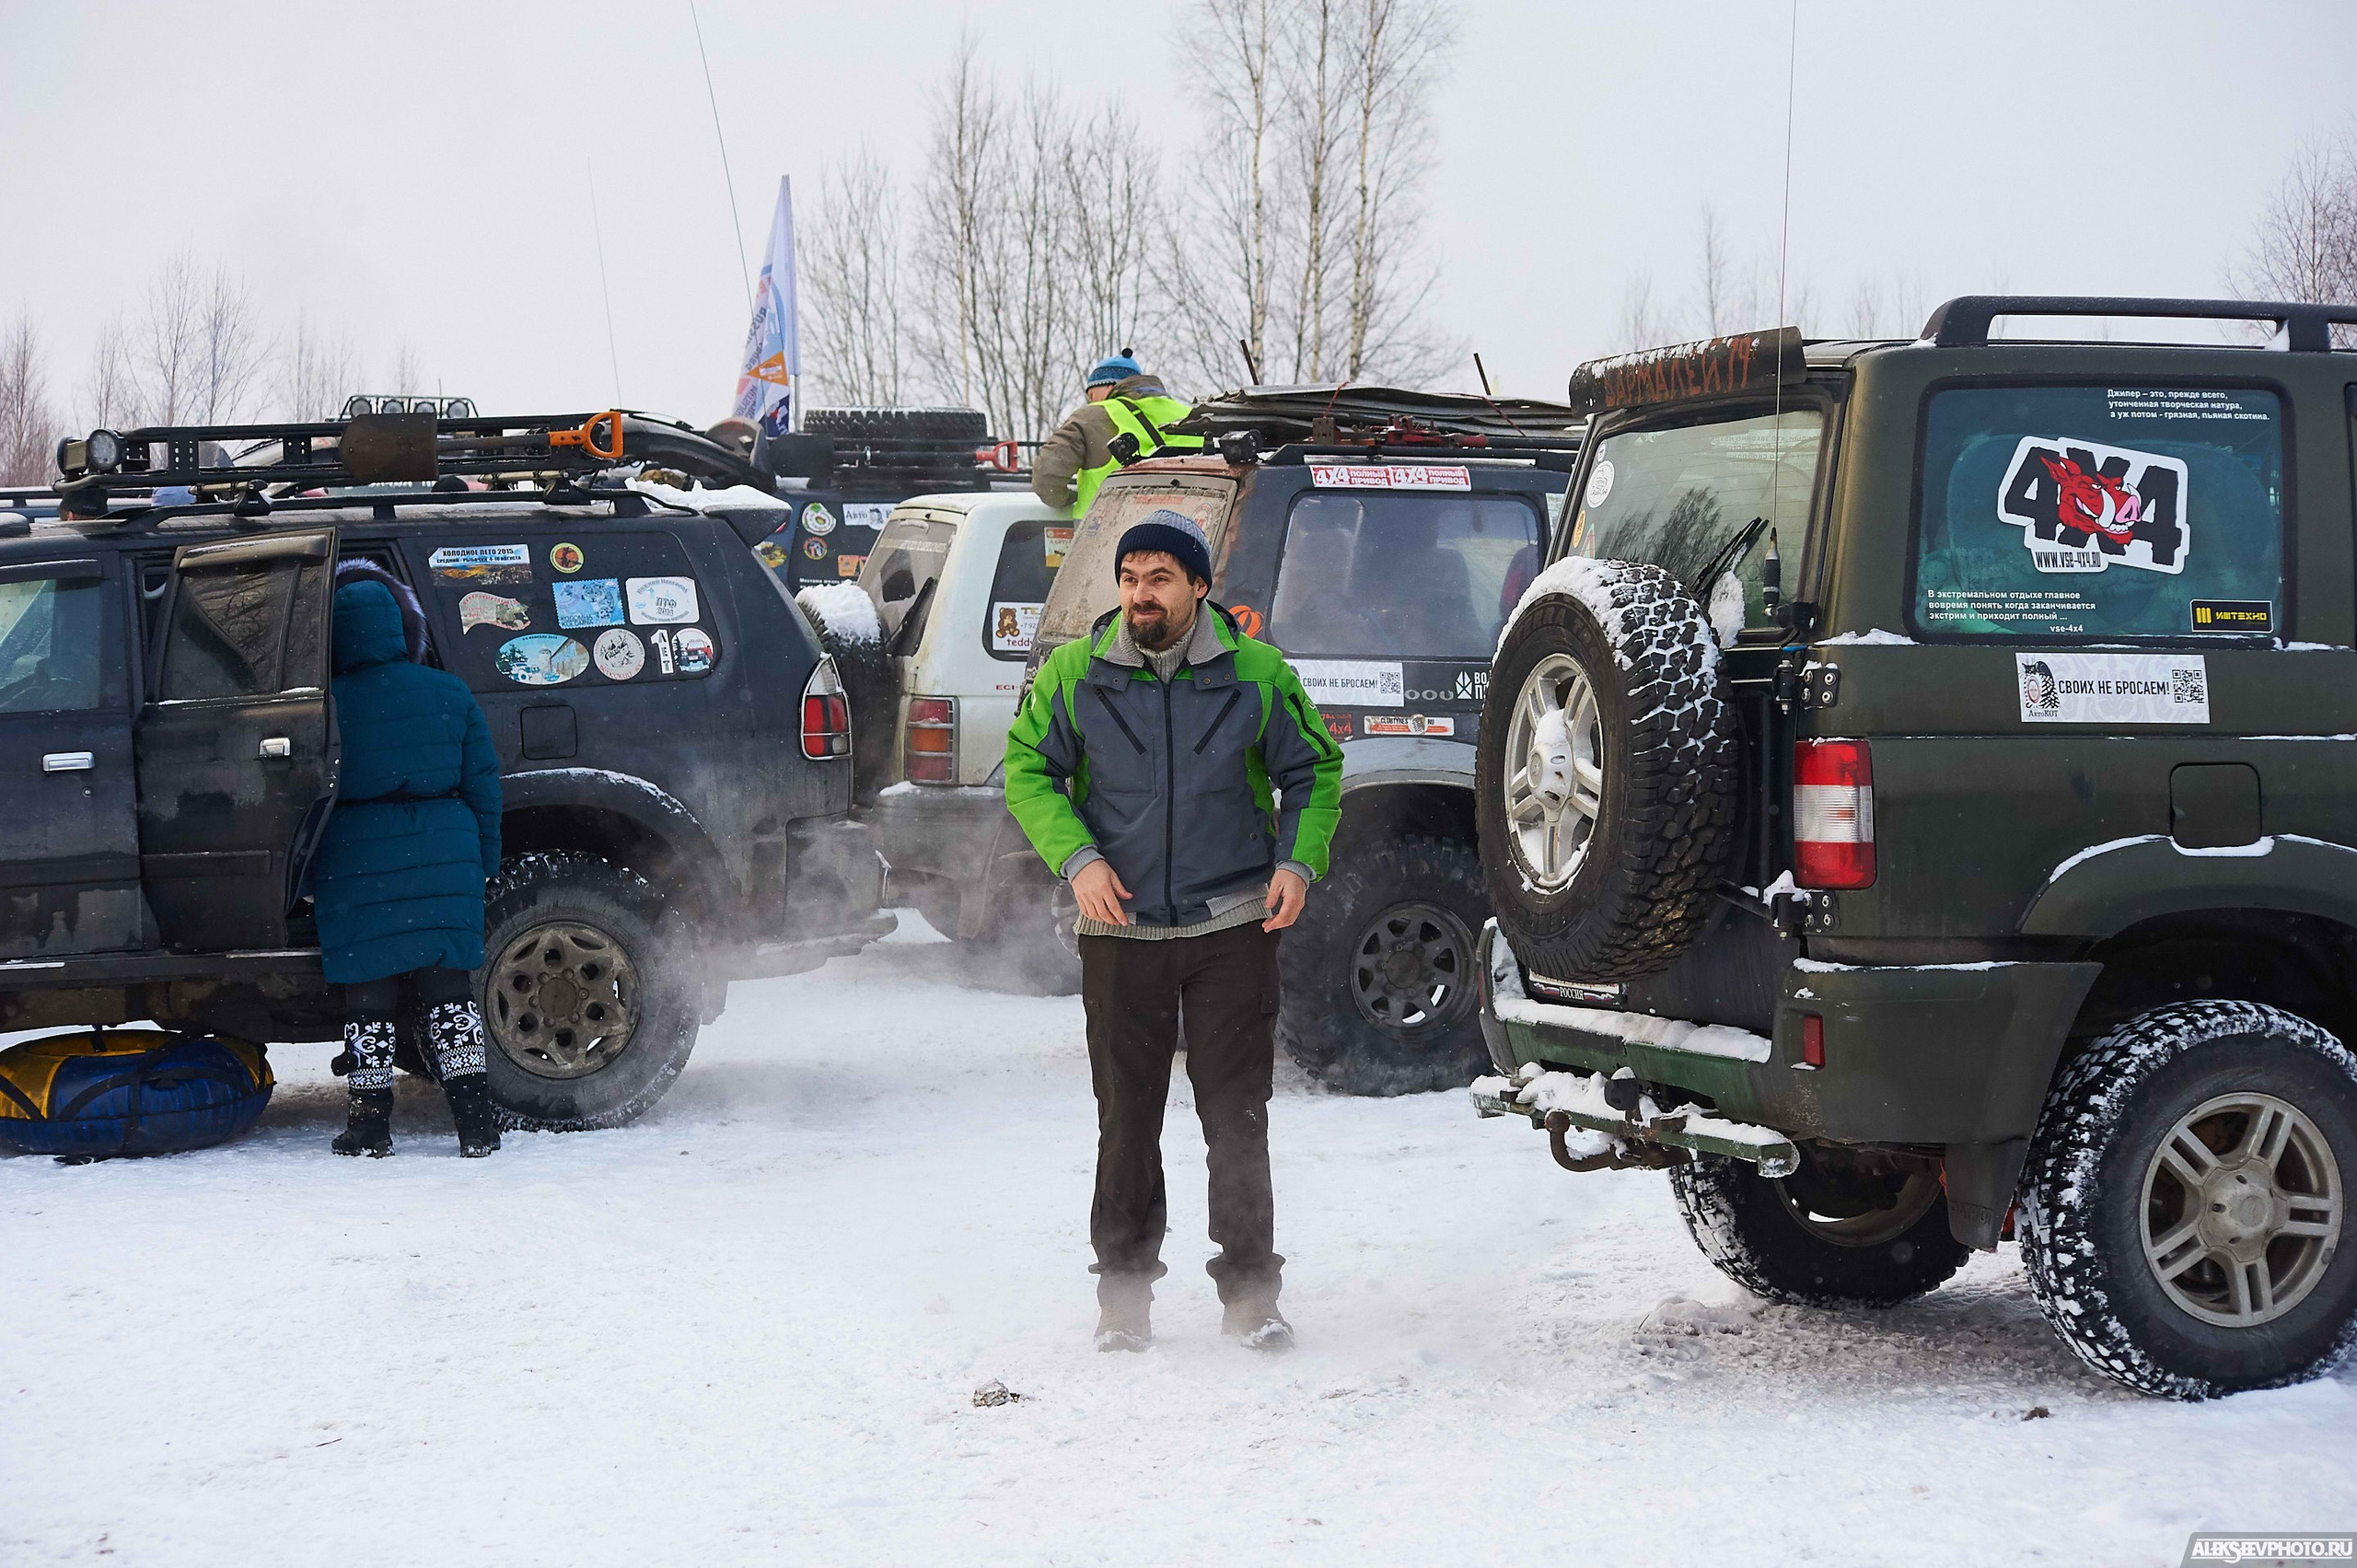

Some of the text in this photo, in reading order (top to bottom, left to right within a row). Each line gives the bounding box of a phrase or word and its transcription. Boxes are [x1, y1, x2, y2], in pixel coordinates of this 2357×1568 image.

[2107, 389, 2141, 399] Джипер
[2150, 391, 2167, 400] это,
[2169, 391, 2200, 400] прежде
[2108, 401, 2243, 411] утонченная творческая натура,
[2118, 412, 2130, 420] уж
[2165, 412, 2200, 420] грязная,
[2234, 412, 2270, 421] скотина.
[1350, 470, 1386, 478] ПОЛНЫЙ
[1428, 469, 1465, 478] ПОЛНЫЙ
[1351, 477, 1388, 486] ПРИВОД
[1429, 476, 1466, 486] ПРИВОД
[1937, 591, 2007, 599] экстремальном
[2009, 592, 2042, 600] отдыхе
[1977, 613, 2020, 621] приходит
[2022, 612, 2058, 621] полный
[1303, 678, 1378, 689] СВОИХ НЕ БРОСАЕМ!
[2058, 680, 2170, 695] СВОИХ НЕ БРОСАЕМ!
[1560, 987, 1585, 1000] РОССИЯ
